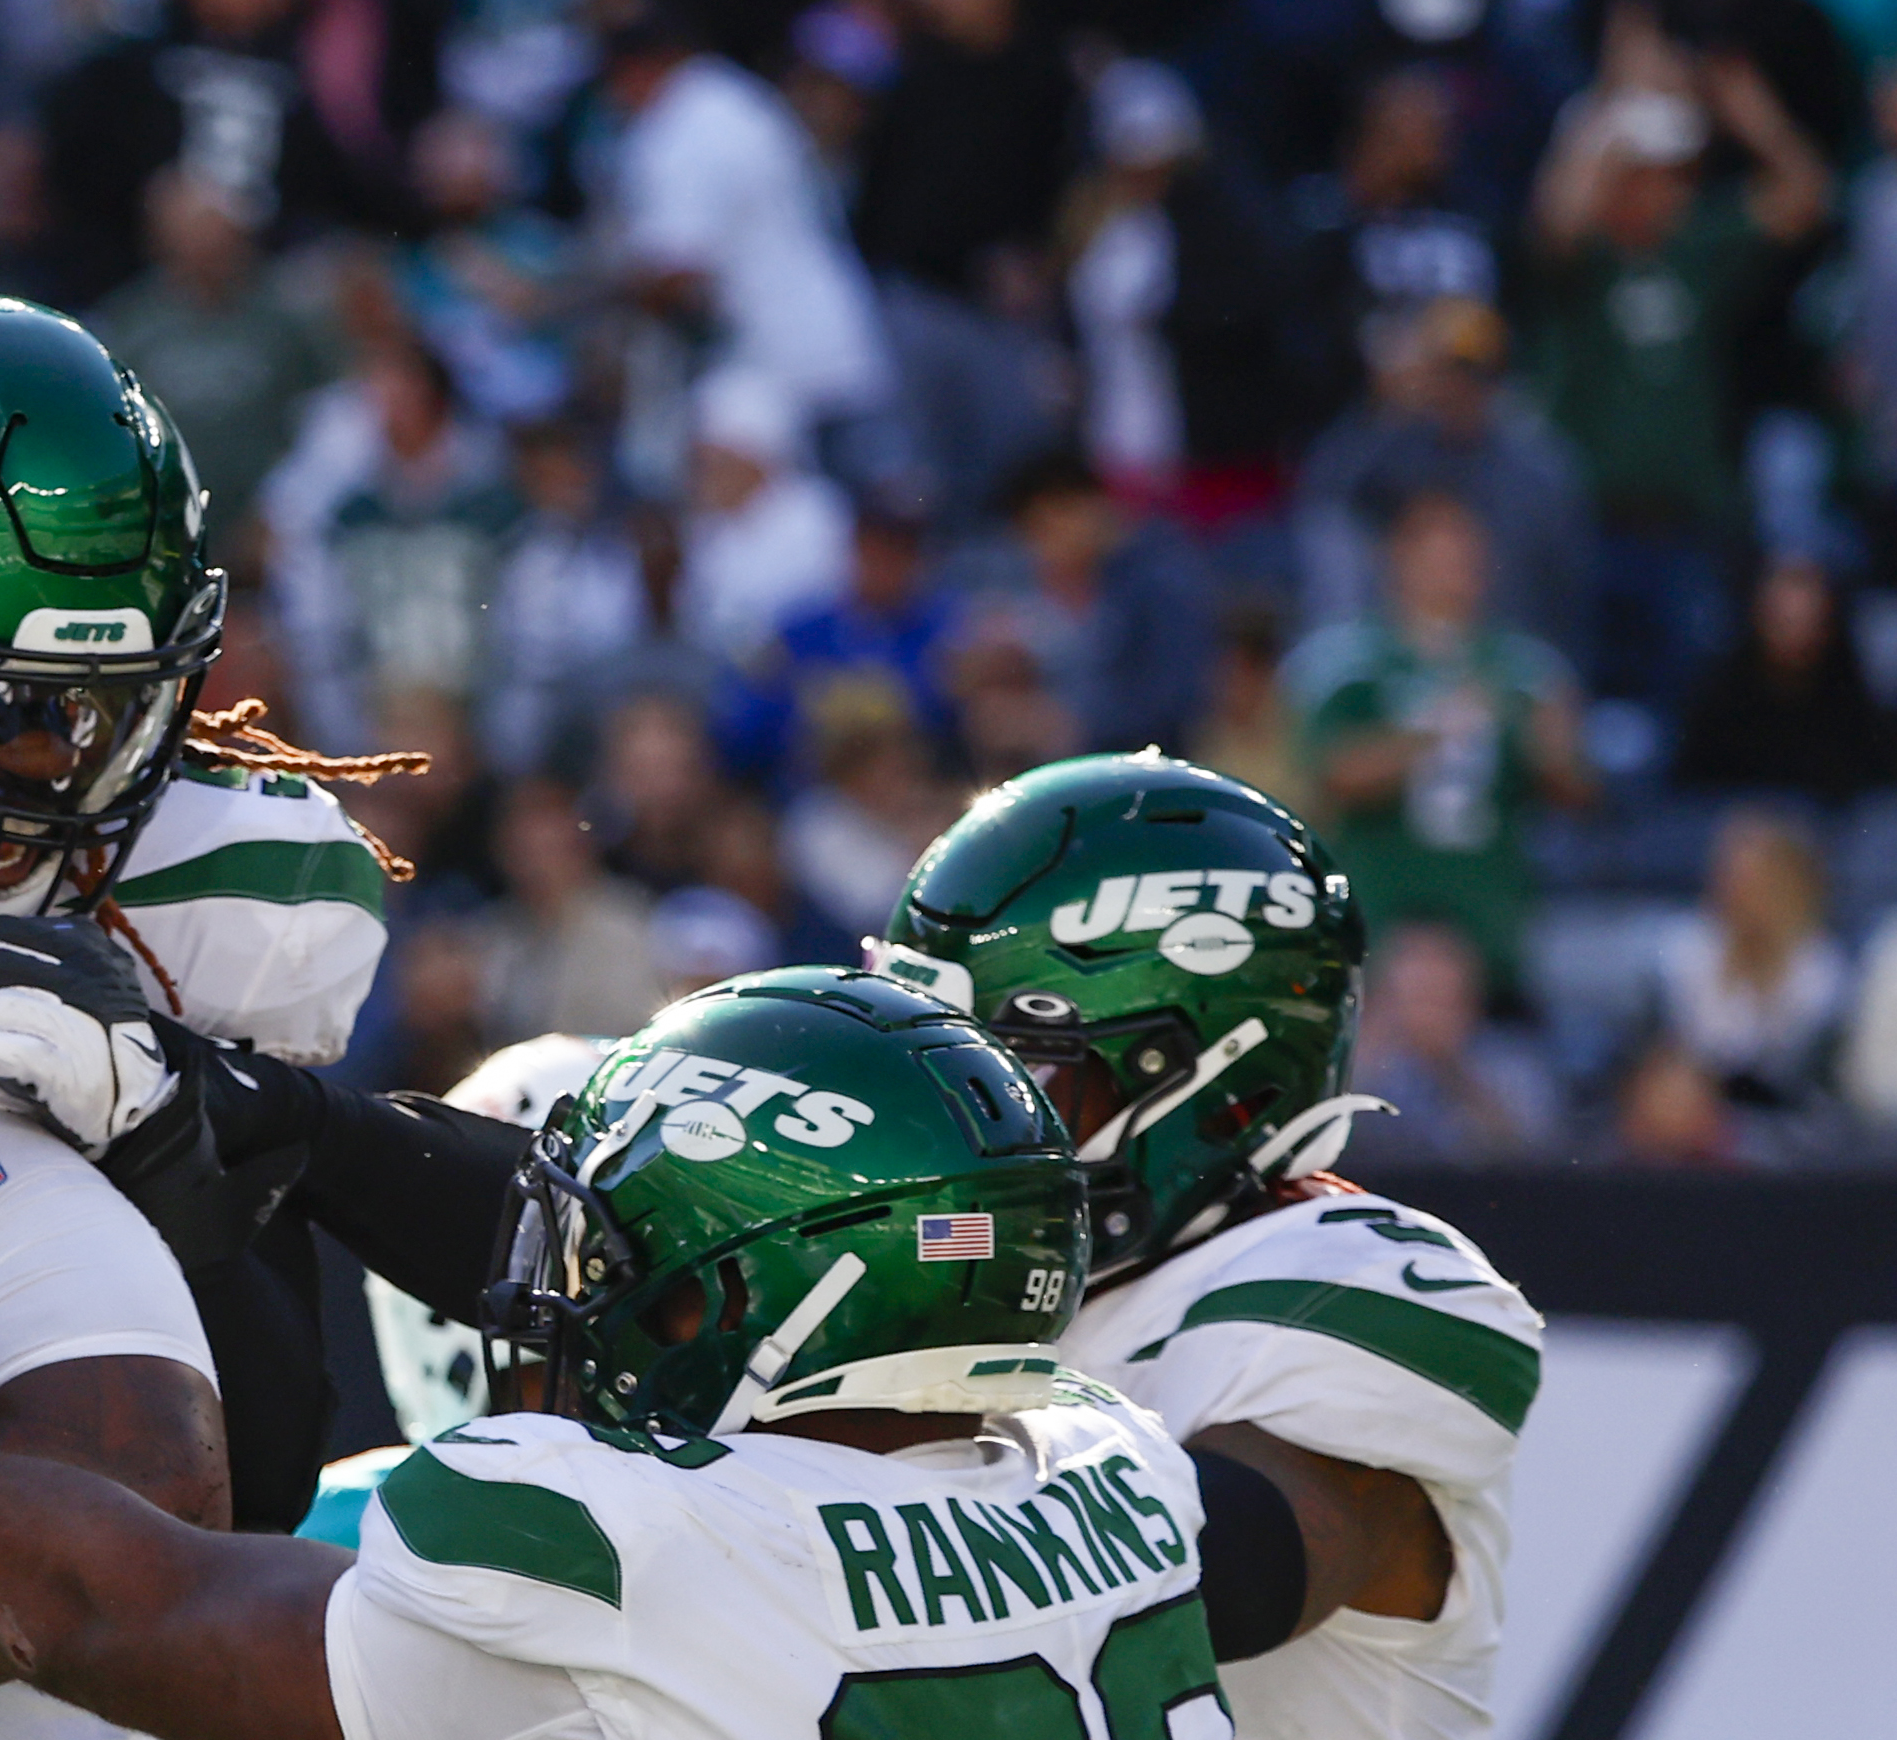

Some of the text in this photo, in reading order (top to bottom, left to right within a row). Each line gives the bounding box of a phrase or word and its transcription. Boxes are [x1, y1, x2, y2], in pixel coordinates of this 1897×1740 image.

[54, 621, 127, 643] JETS
[1049, 868, 1317, 945] JETS
[604, 1047, 876, 1149] JETS
[1020, 1268, 1066, 1313] 98
[817, 1454, 1189, 1632] RANKINS
